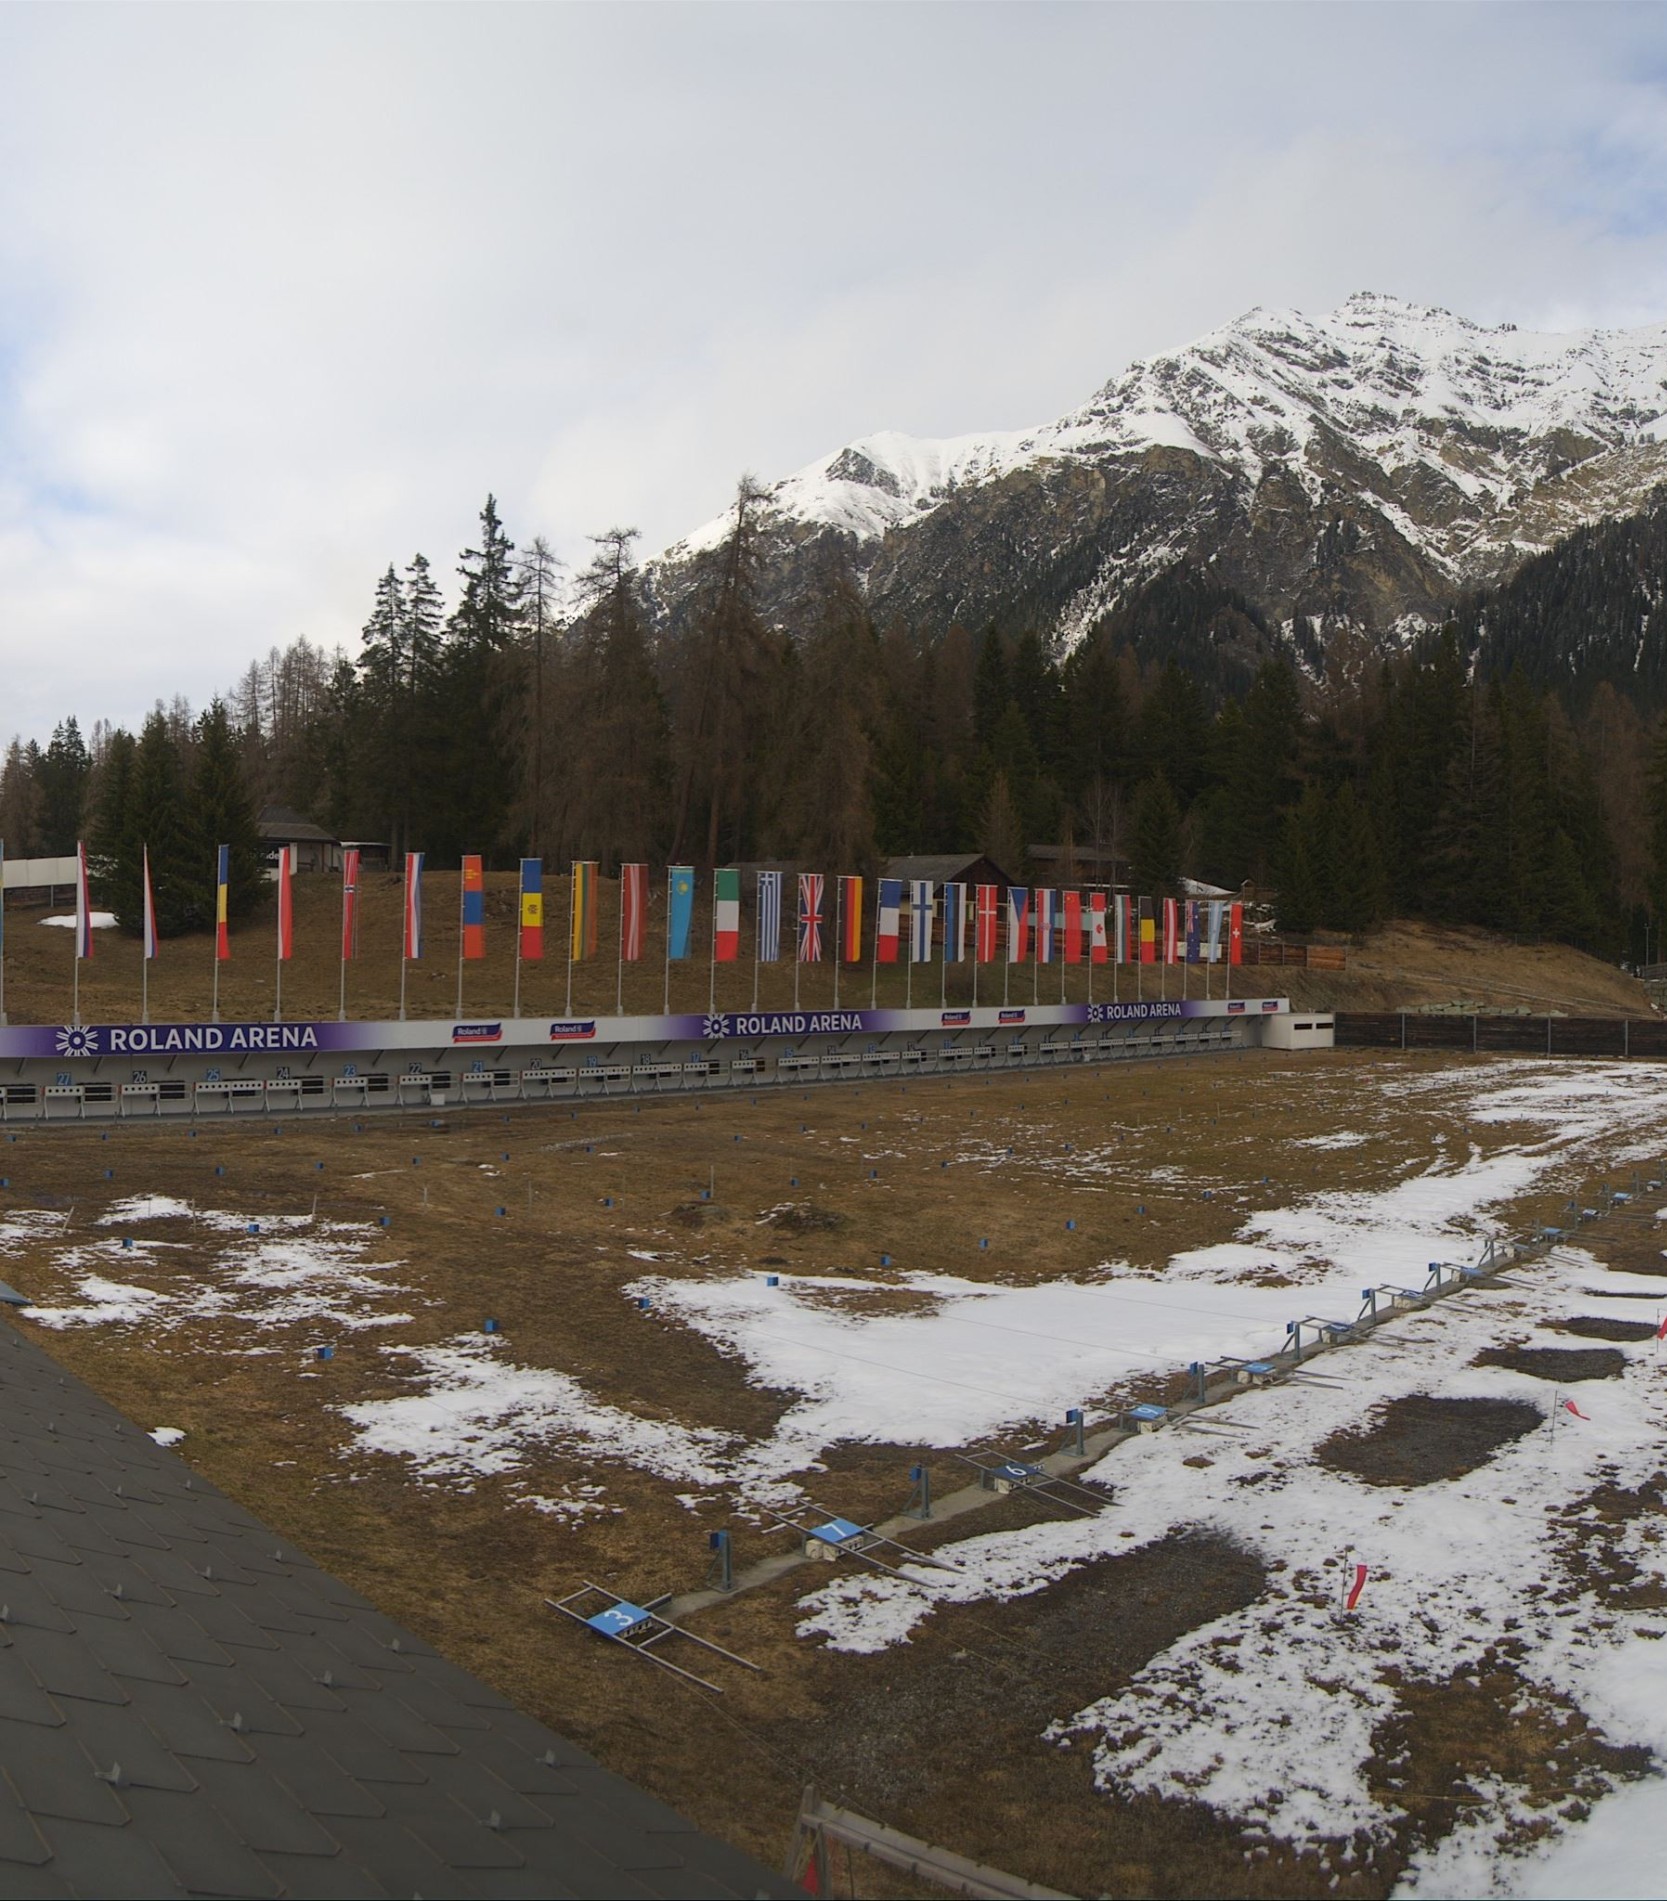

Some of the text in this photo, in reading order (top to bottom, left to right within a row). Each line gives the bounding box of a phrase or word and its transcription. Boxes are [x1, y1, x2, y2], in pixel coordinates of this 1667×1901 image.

[1107, 1003, 1181, 1019] ROLAND ARENA
[554, 1024, 577, 1033] Roland
[736, 1013, 862, 1035] ROLAND ARENA
[457, 1027, 481, 1035] Roland
[110, 1026, 318, 1052] ROLAND ARENA
[410, 1063, 421, 1073] 22
[473, 1062, 484, 1072] 21
[531, 1059, 541, 1069] 20
[208, 1069, 220, 1081] 25
[278, 1068, 290, 1079] 24
[345, 1065, 356, 1076] 23
[58, 1073, 70, 1085] 27
[134, 1072, 146, 1083] 26
[604, 1610, 634, 1626] 3
